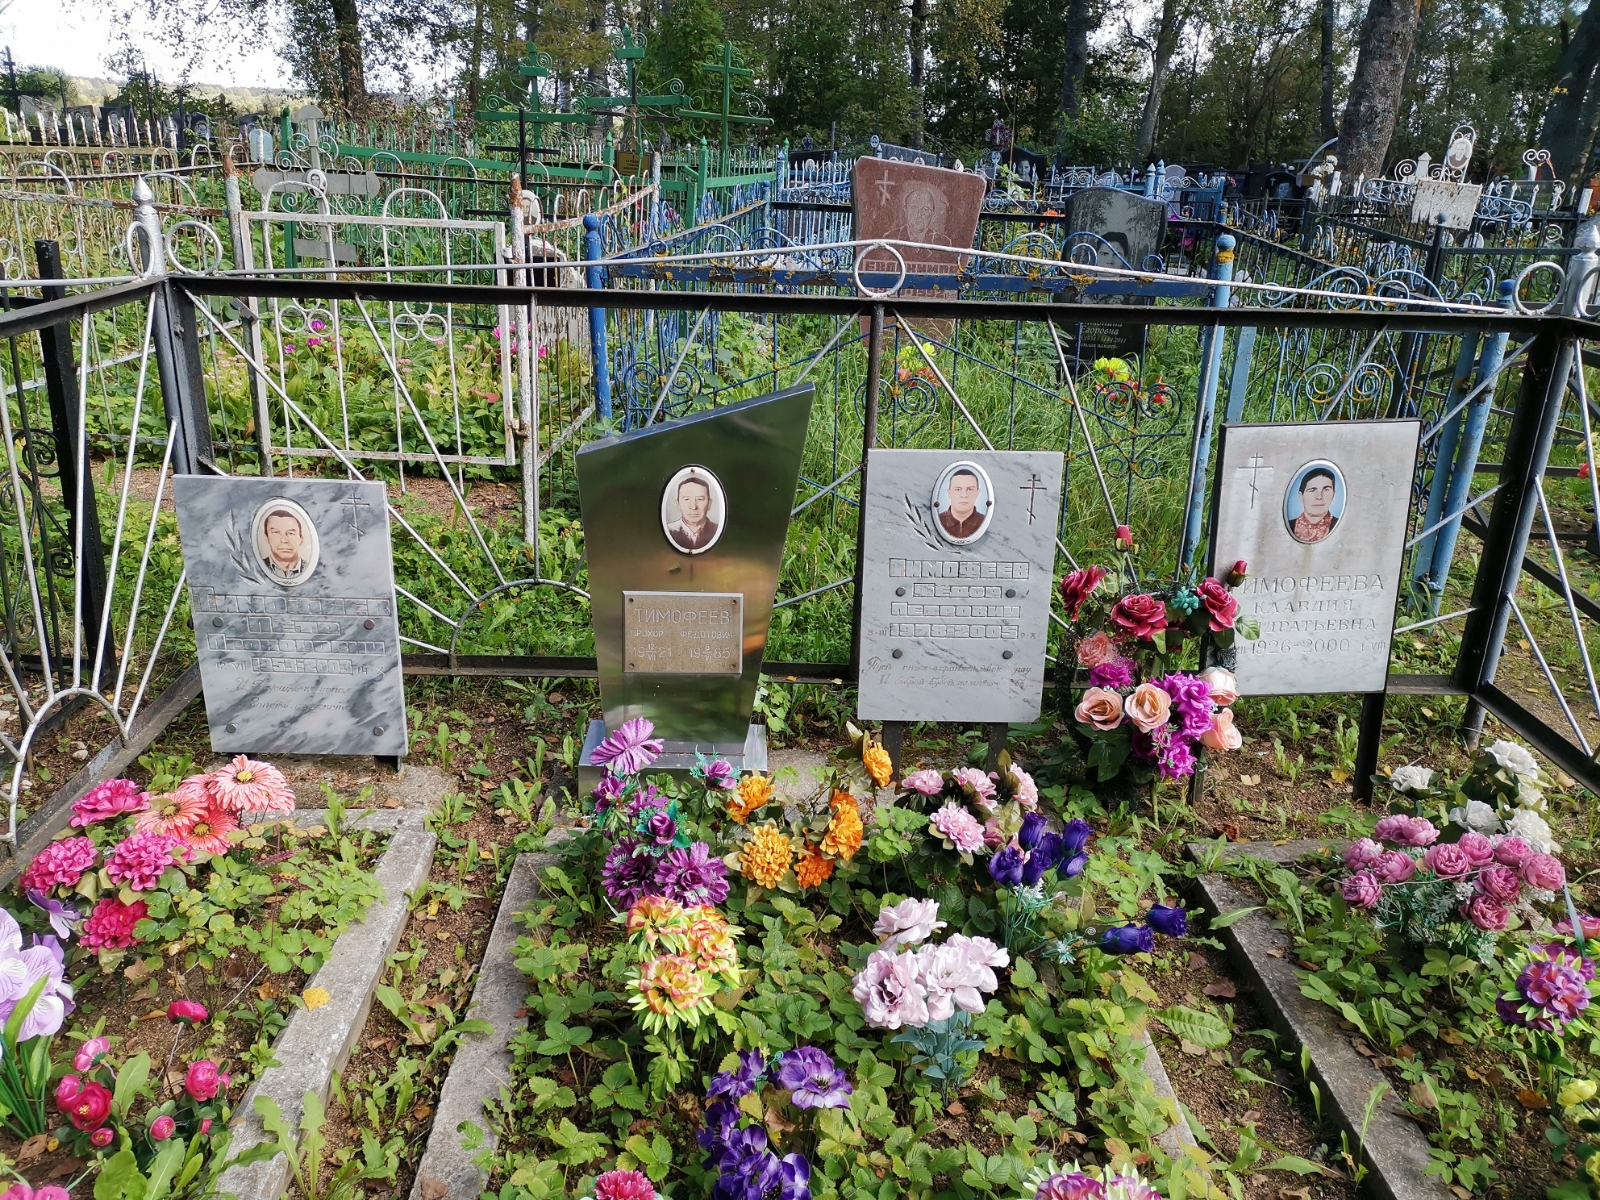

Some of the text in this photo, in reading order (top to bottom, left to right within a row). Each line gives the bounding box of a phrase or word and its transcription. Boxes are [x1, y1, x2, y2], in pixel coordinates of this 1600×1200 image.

[1232, 574, 1384, 595] ИМОФЕЕВА
[1254, 599, 1354, 615] КЛАВДИЯ
[634, 608, 732, 625] ТИМОФЕЕВ
[1258, 618, 1377, 633] ДРАТЬЕВНА
[631, 629, 733, 639] ПРОХОР ФЕДОТОВИЧ
